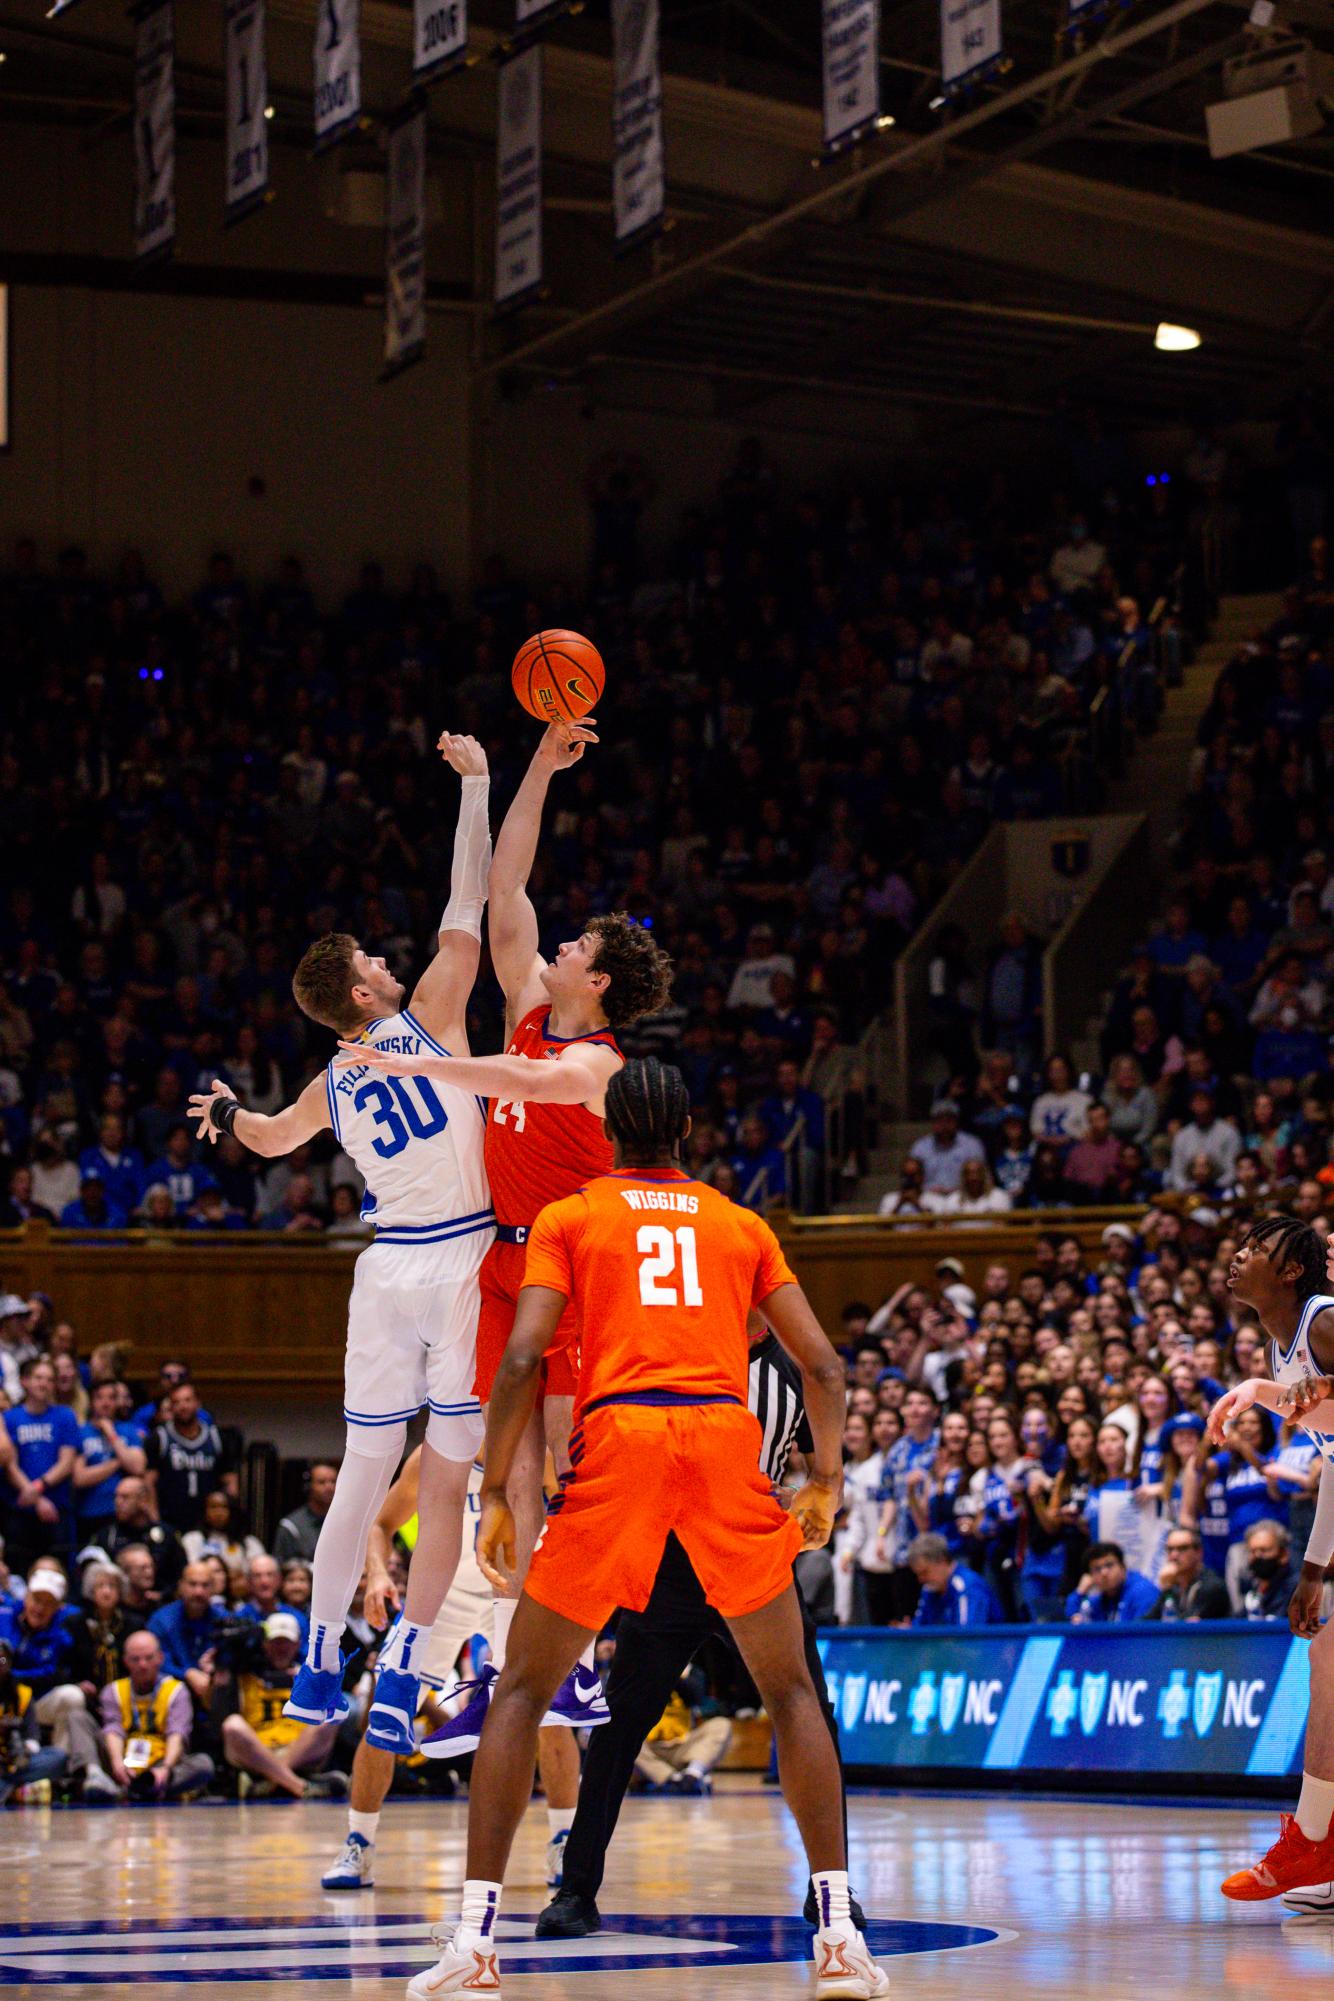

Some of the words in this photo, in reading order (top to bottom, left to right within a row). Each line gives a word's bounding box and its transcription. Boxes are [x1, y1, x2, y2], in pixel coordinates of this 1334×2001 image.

[354, 1075, 448, 1159] 30
[620, 1190, 699, 1214] WIGGINS
[636, 1225, 703, 1306] 21
[864, 1680, 902, 1724] NC
[963, 1680, 1002, 1725] NC
[1106, 1680, 1148, 1727] NC
[1222, 1679, 1266, 1728] NC
